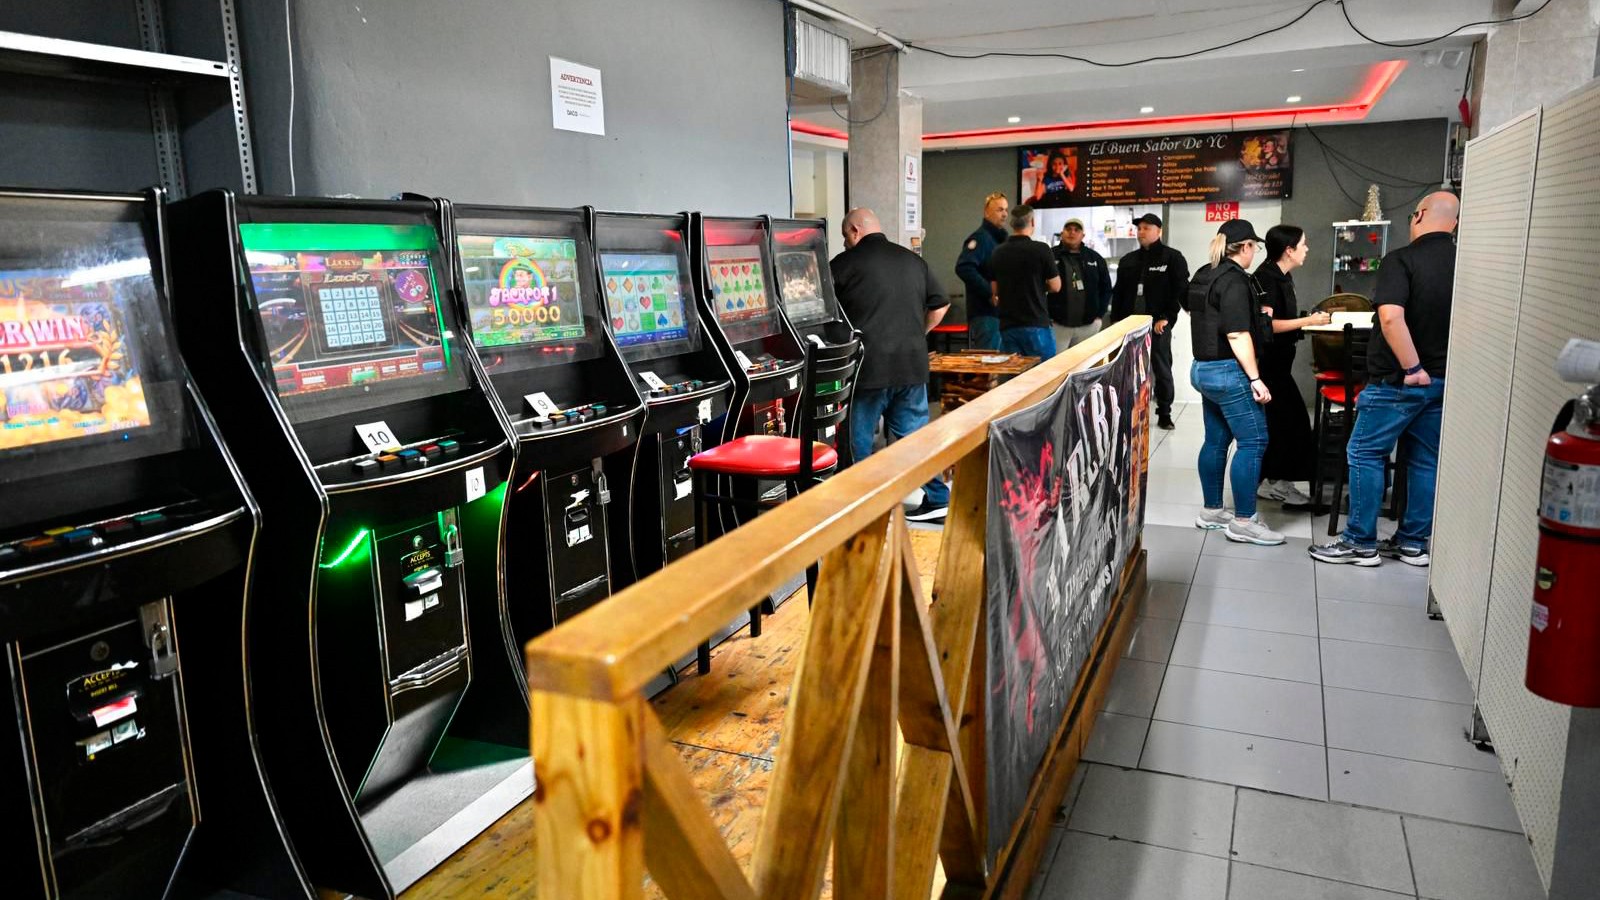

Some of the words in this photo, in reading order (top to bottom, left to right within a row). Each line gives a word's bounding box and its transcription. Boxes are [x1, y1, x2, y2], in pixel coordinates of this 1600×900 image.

[560, 73, 593, 86] ADVERTENCIA
[1089, 141, 1107, 155] El
[1108, 142, 1140, 154] Buen
[1142, 138, 1181, 153] Sabor
[1183, 136, 1203, 149] De
[1207, 134, 1228, 149] YC
[1216, 203, 1230, 211] NO
[324, 272, 370, 283] Lucky
[489, 287, 550, 307] JACKPOT
[552, 286, 557, 301] 1
[494, 306, 560, 325] 50000
[29, 317, 87, 343] WIN
[538, 400, 548, 409] 9
[368, 430, 390, 446] 10
